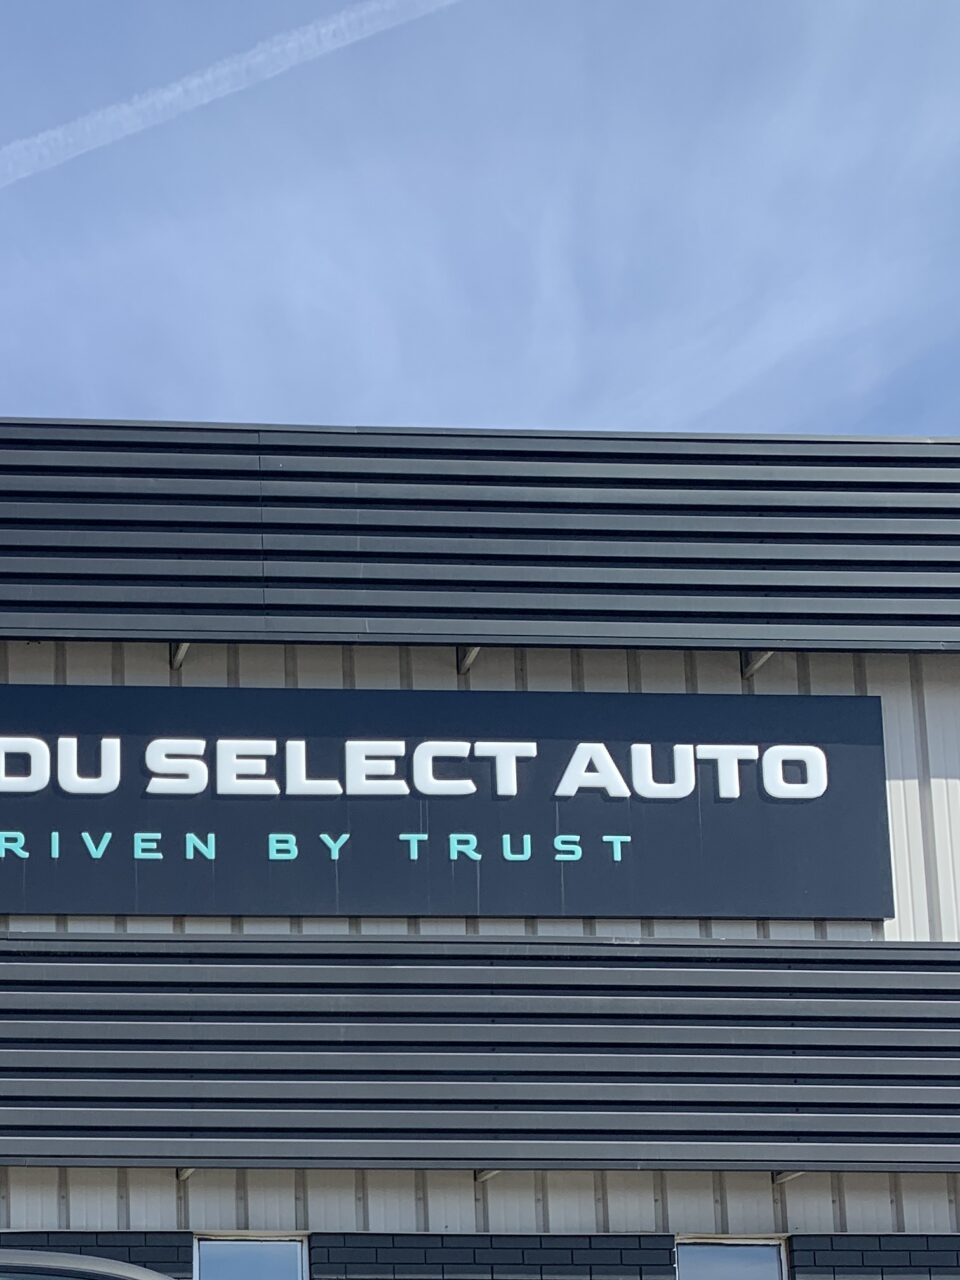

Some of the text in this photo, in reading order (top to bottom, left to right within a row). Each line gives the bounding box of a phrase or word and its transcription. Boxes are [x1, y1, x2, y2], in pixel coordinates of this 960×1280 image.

[144, 738, 538, 797] SELECT
[554, 742, 828, 799] AUTO
[267, 833, 351, 861] BY
[398, 833, 632, 862] TRUST
